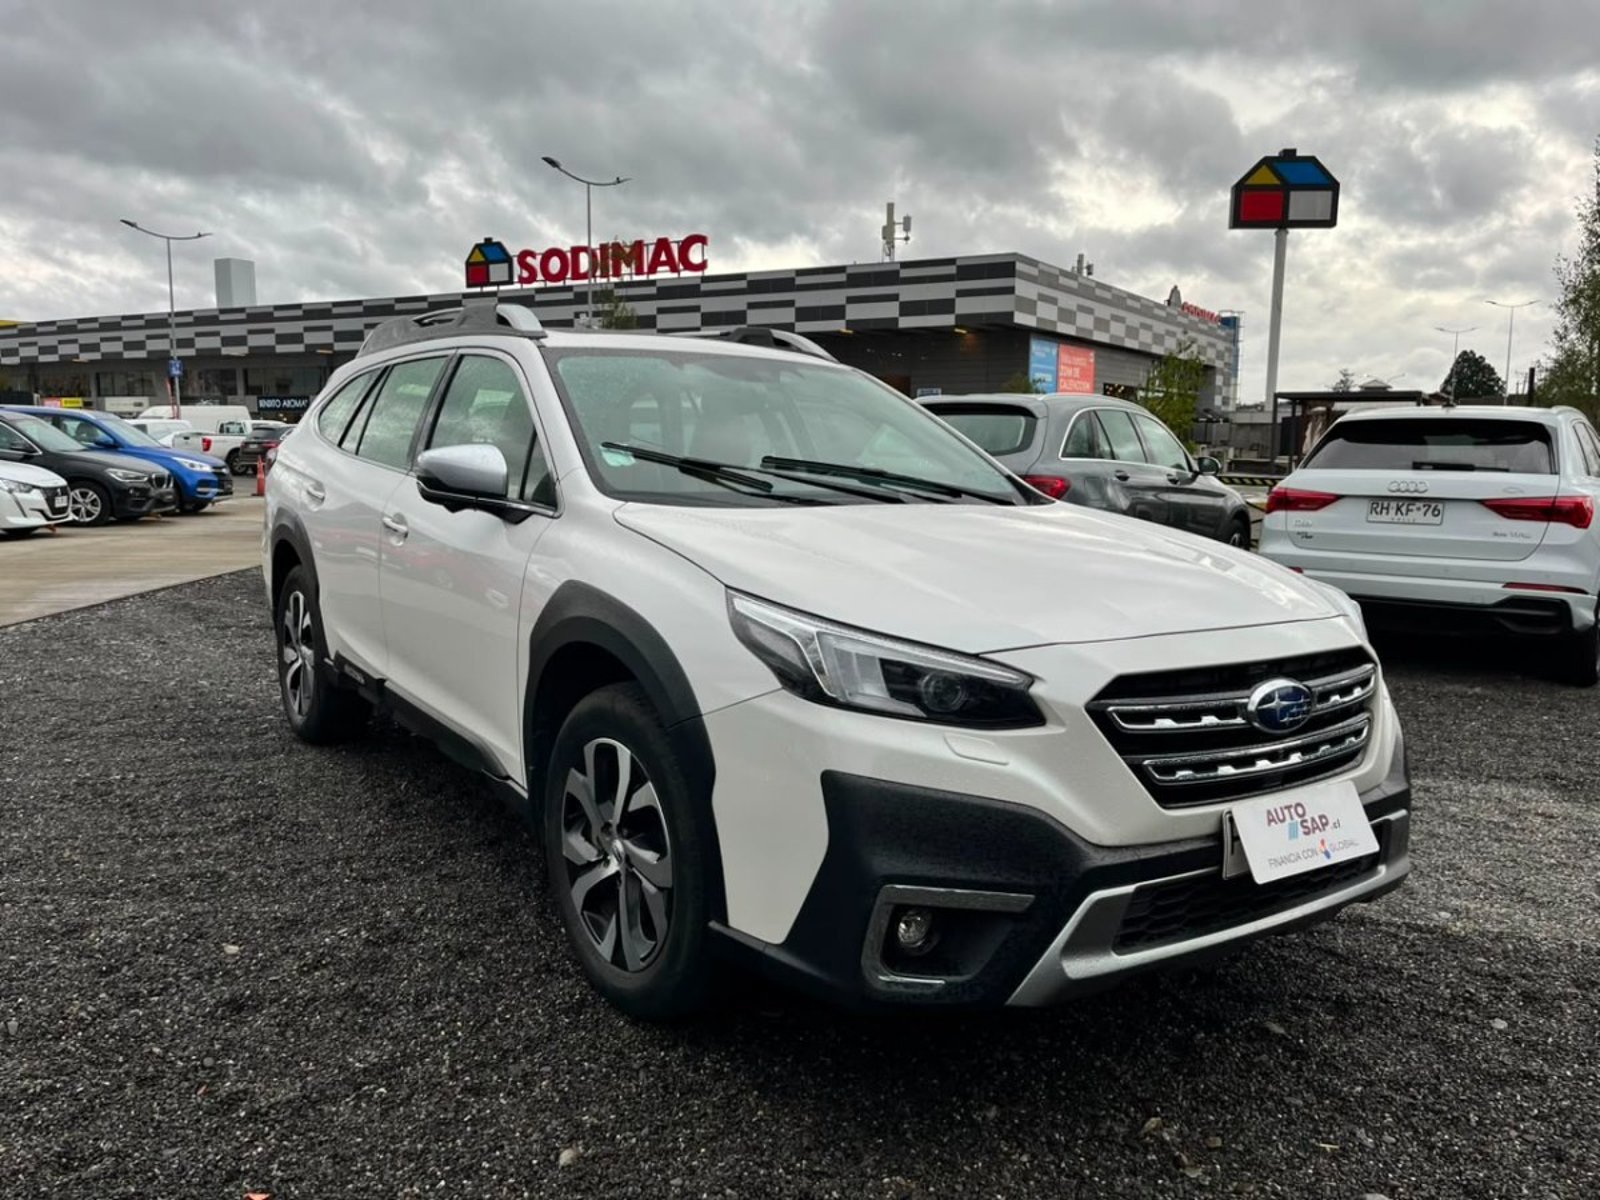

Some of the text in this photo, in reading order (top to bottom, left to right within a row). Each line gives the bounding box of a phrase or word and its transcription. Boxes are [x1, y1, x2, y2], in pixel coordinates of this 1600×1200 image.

[517, 234, 708, 284] SODIMAC
[1266, 802, 1306, 826] AUTO
[1268, 851, 1302, 869] FINANCIA
[1302, 848, 1319, 860] CON
